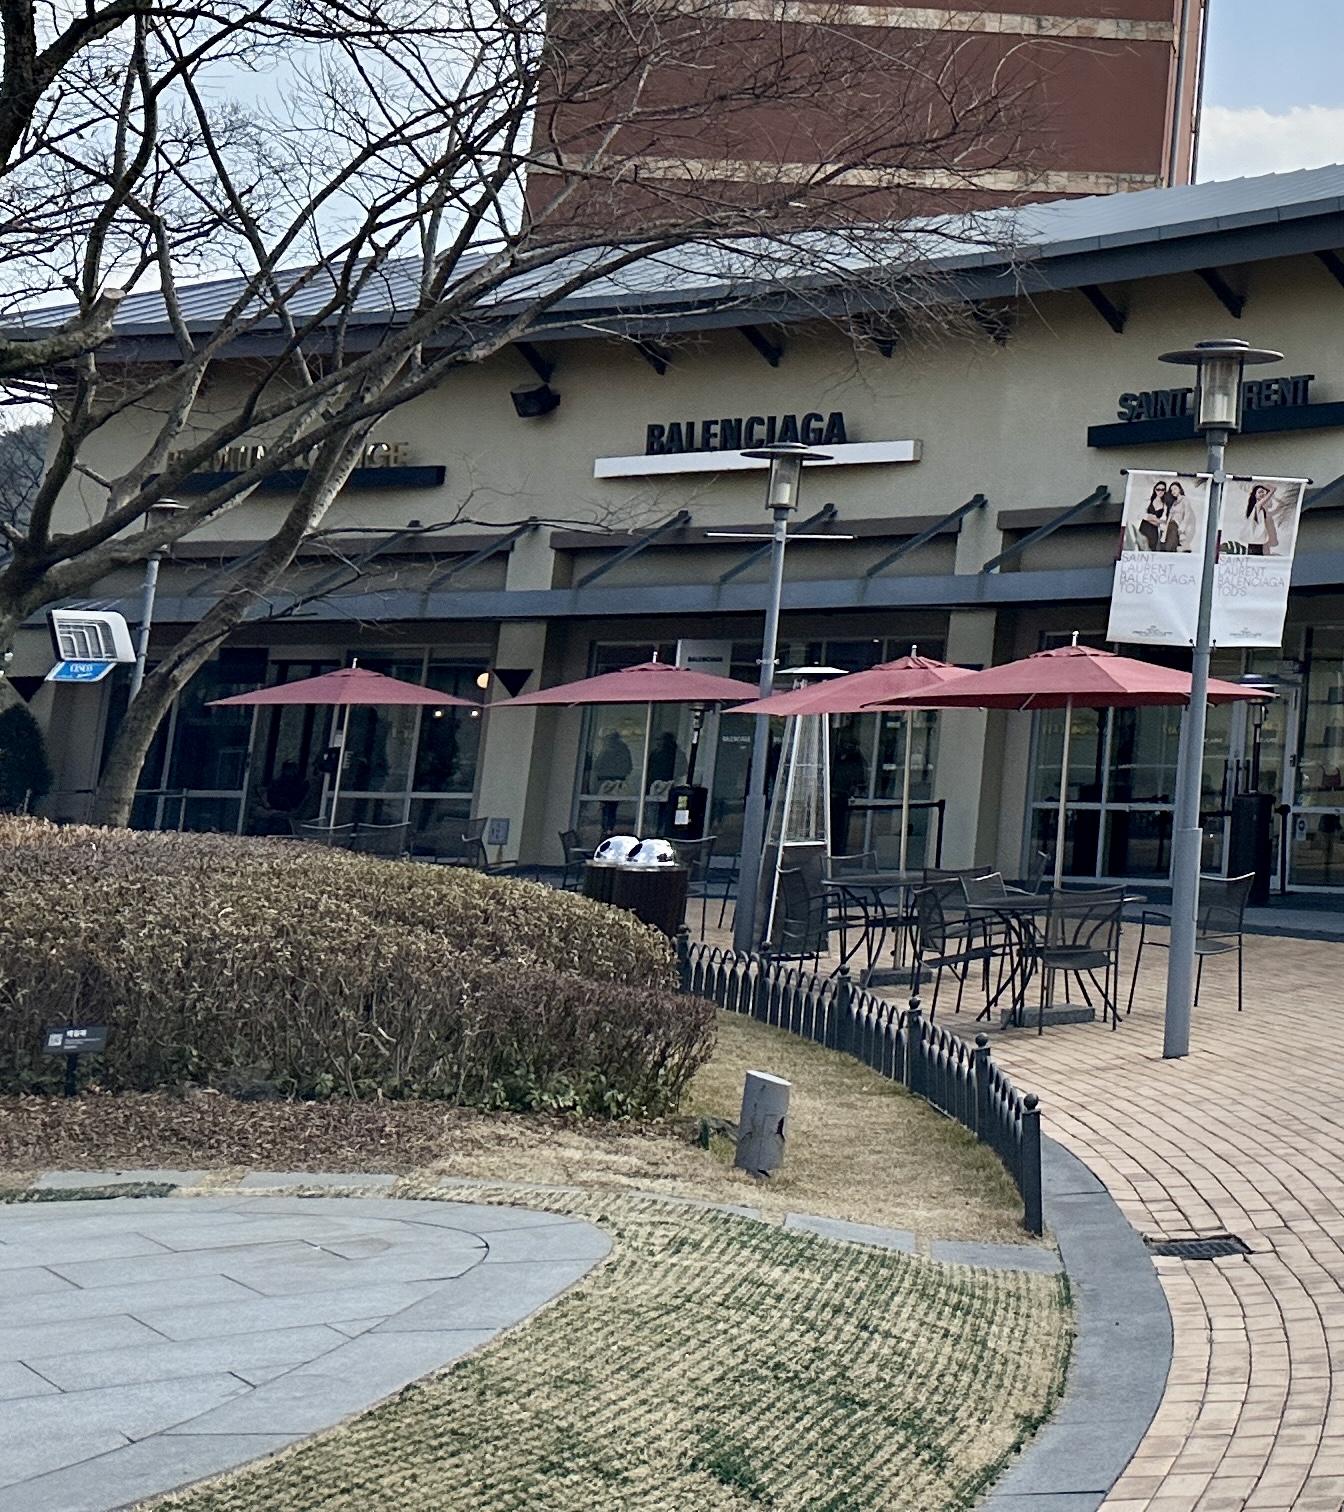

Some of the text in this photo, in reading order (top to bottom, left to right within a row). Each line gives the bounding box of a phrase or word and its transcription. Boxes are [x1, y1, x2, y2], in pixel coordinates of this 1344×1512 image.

[1117, 387, 1192, 421] SAINT
[646, 412, 847, 455] BALENCIAGA
[1122, 553, 1156, 563] SAINT
[1219, 556, 1250, 566] SAINT
[1121, 563, 1175, 574] LAURENT
[1218, 566, 1266, 577] LAURENT
[1119, 573, 1196, 585] BALENCIAGA
[1217, 576, 1285, 587] BALENCIAGA
